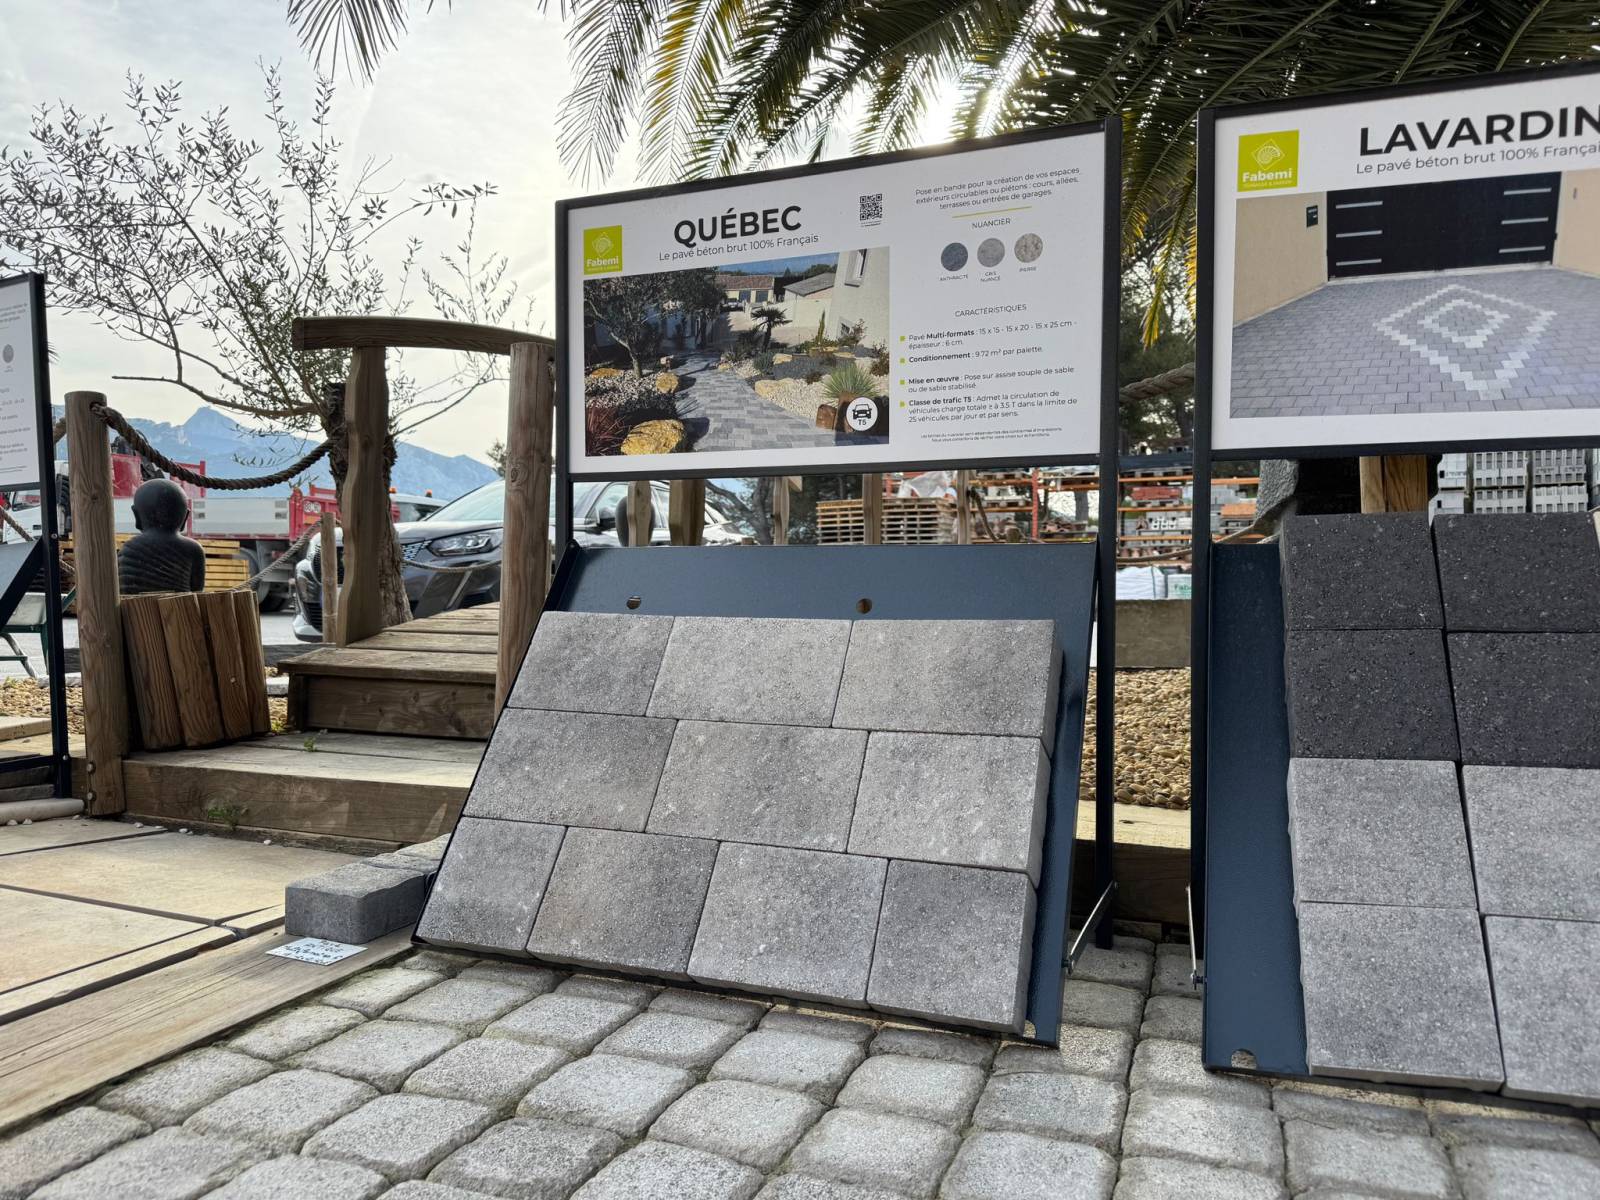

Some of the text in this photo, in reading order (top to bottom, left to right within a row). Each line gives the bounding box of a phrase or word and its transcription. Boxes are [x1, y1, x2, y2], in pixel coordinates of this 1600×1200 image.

[1360, 104, 1600, 156] LAVARDIN
[1356, 162, 1373, 174] Le
[1377, 157, 1411, 175] pavé
[1416, 154, 1459, 169] béton
[1464, 151, 1496, 165] brut
[1500, 147, 1539, 160] 100%
[916, 188, 932, 196] Pose
[944, 184, 966, 192] bande
[968, 181, 984, 190] pour
[994, 175, 1024, 185] création
[1050, 167, 1080, 177] espaces
[1242, 167, 1293, 183] Fabemi
[916, 194, 950, 204] extérieurs
[950, 188, 988, 200] circulables
[1000, 183, 1028, 194] piétons
[940, 201, 970, 210] terrasses
[982, 195, 1010, 204] entrées
[674, 205, 802, 248] QUÉBEC
[972, 217, 1011, 229] NUANCIER
[659, 233, 819, 261] Le pavé béton brut 100% Français
[586, 255, 619, 267] Fabemi
[926, 329, 975, 340] Multi-formats
[993, 326, 1000, 334] 15
[1036, 322, 1042, 330] 15
[908, 340, 941, 350] épaisseur
[908, 352, 971, 363] Conditionnement
[1002, 348, 1015, 356] par
[982, 372, 994, 380] sur
[994, 370, 1016, 378] assise
[1018, 368, 1042, 377] souple
[1054, 366, 1074, 374] sable
[928, 384, 946, 392] sable
[942, 396, 962, 404] trafic
[976, 394, 1000, 402] Admet
[1010, 391, 1048, 400] circulation
[908, 406, 940, 414] véhicules
[942, 405, 966, 413] charge
[1018, 400, 1036, 408] dans
[1044, 398, 1066, 406] limite
[918, 414, 950, 422] véhicules
[964, 413, 978, 421] jour
